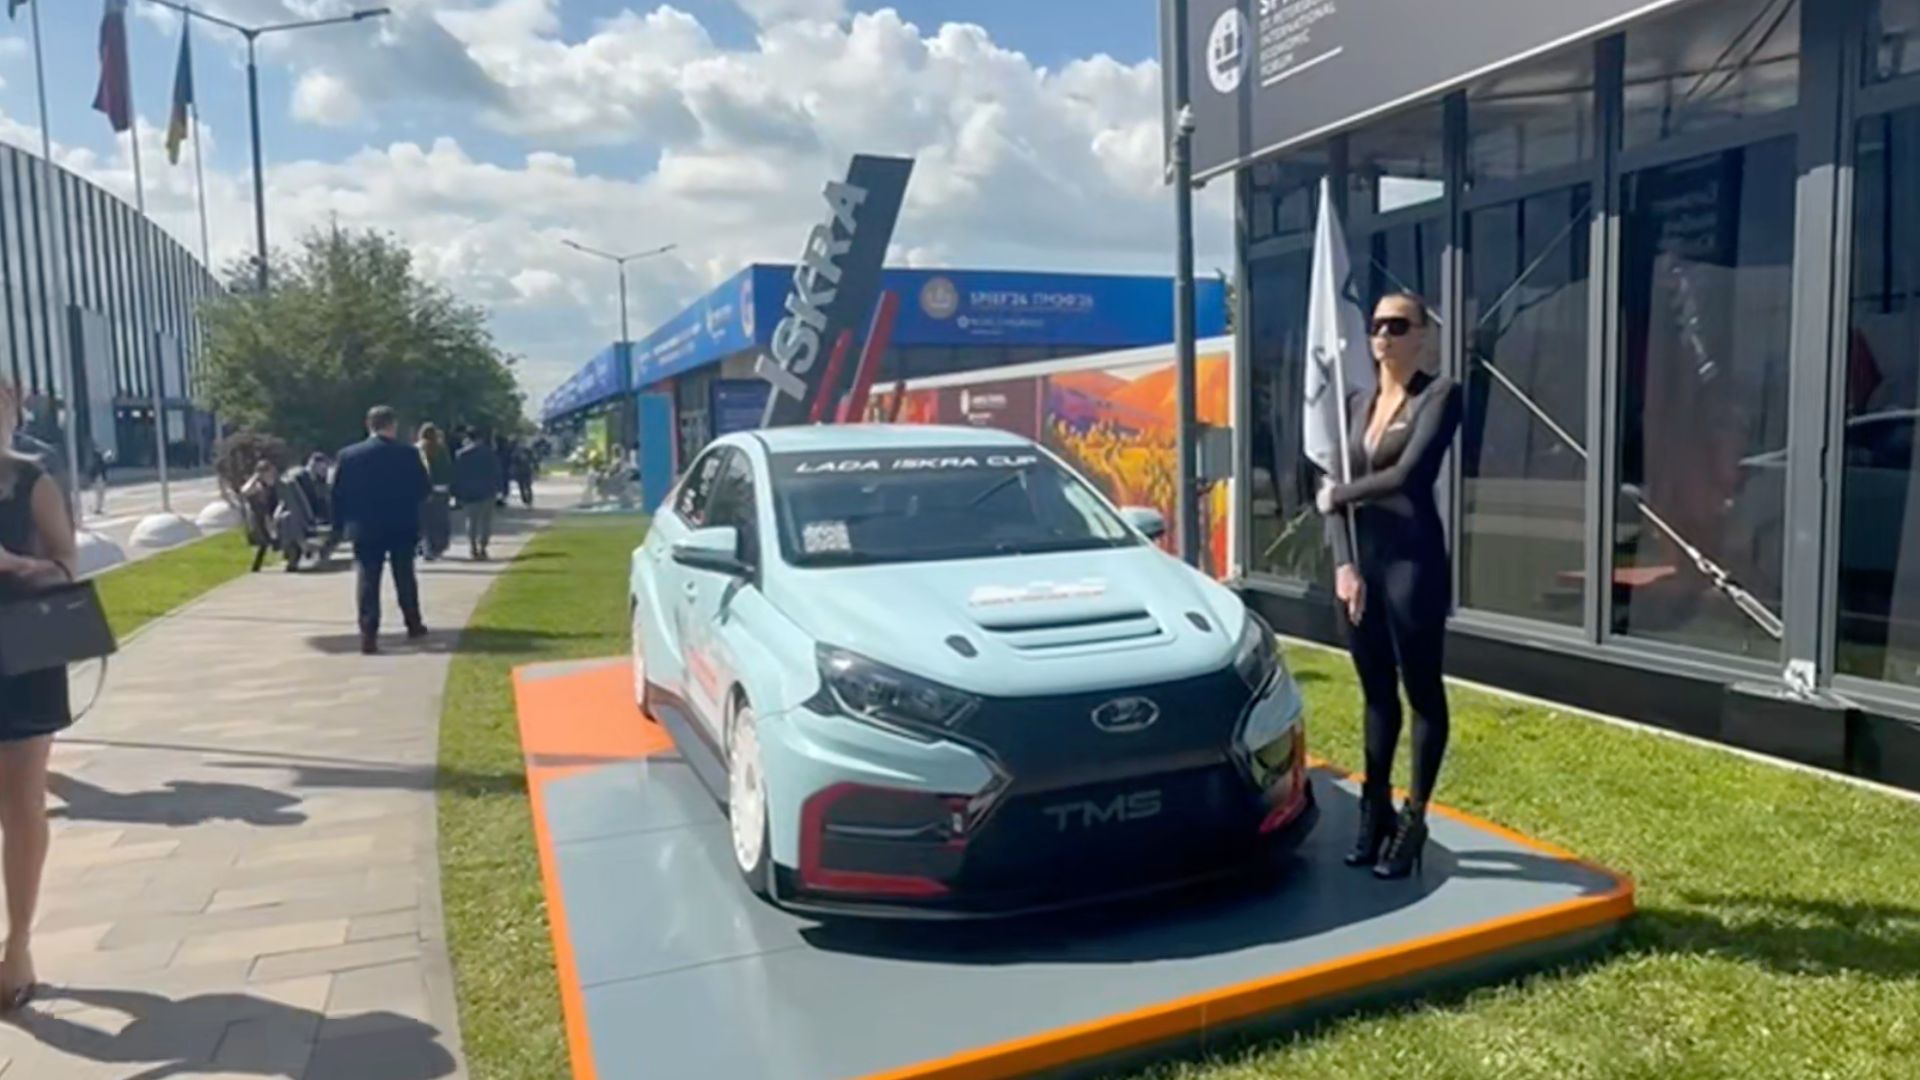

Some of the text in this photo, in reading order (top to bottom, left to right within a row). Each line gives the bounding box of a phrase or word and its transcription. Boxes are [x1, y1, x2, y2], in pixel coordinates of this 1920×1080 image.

[755, 181, 868, 402] ISKRA
[796, 455, 1037, 473] LADA ISKRA CUP
[1042, 790, 1162, 831] TMS
